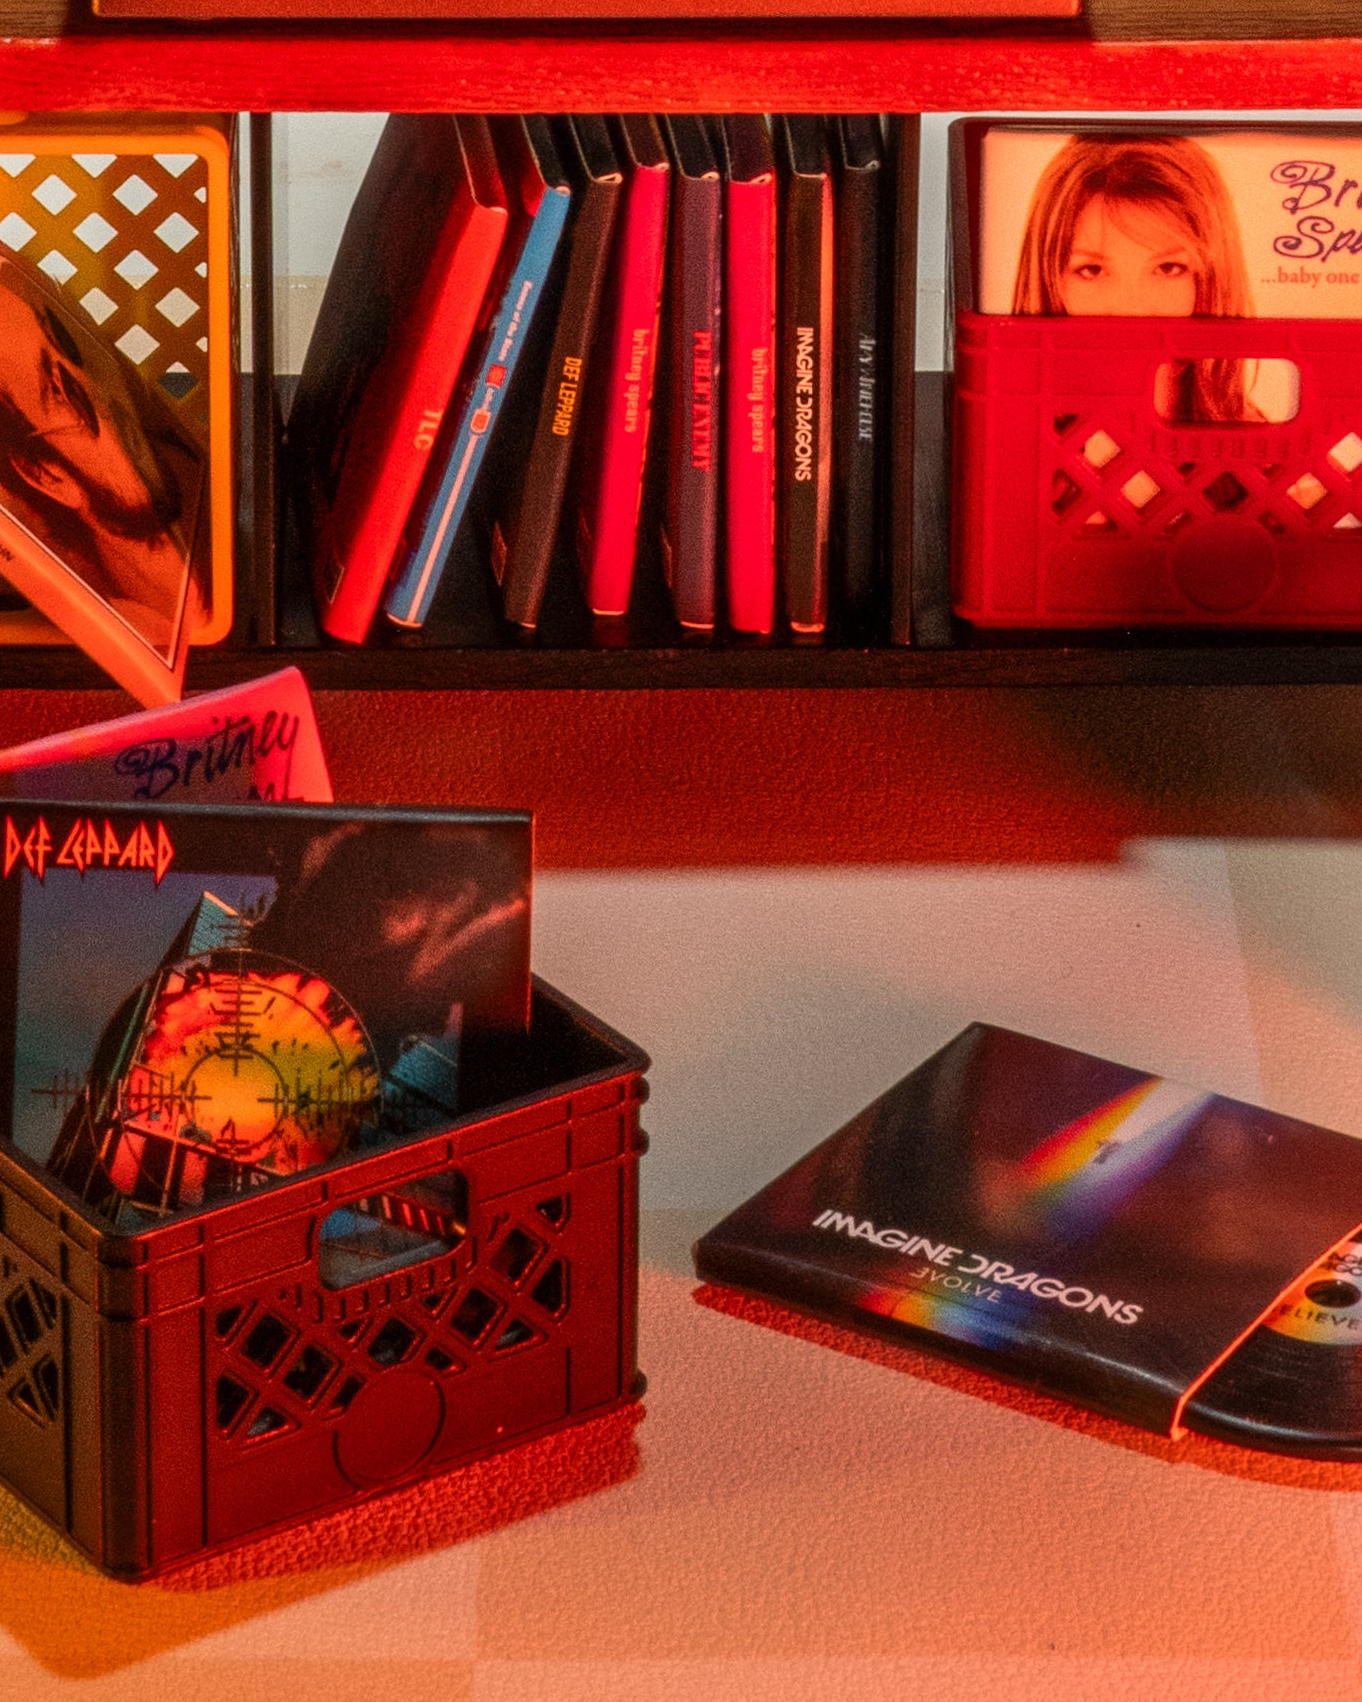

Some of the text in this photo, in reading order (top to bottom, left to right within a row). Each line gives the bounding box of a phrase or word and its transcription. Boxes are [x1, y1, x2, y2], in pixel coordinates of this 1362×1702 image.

[1325, 270, 1361, 286] one
[551, 356, 583, 437] DEF LEPPARD
[623, 328, 650, 433] britney spears
[747, 347, 769, 454] britney spears
[794, 326, 814, 482] IMAGINE DRAGONS
[413, 408, 444, 452] TLC
[113, 709, 300, 801] Britney
[3, 813, 176, 887] DEF LEPPARD
[811, 1208, 1144, 1325] IMAGINE DRAGONS
